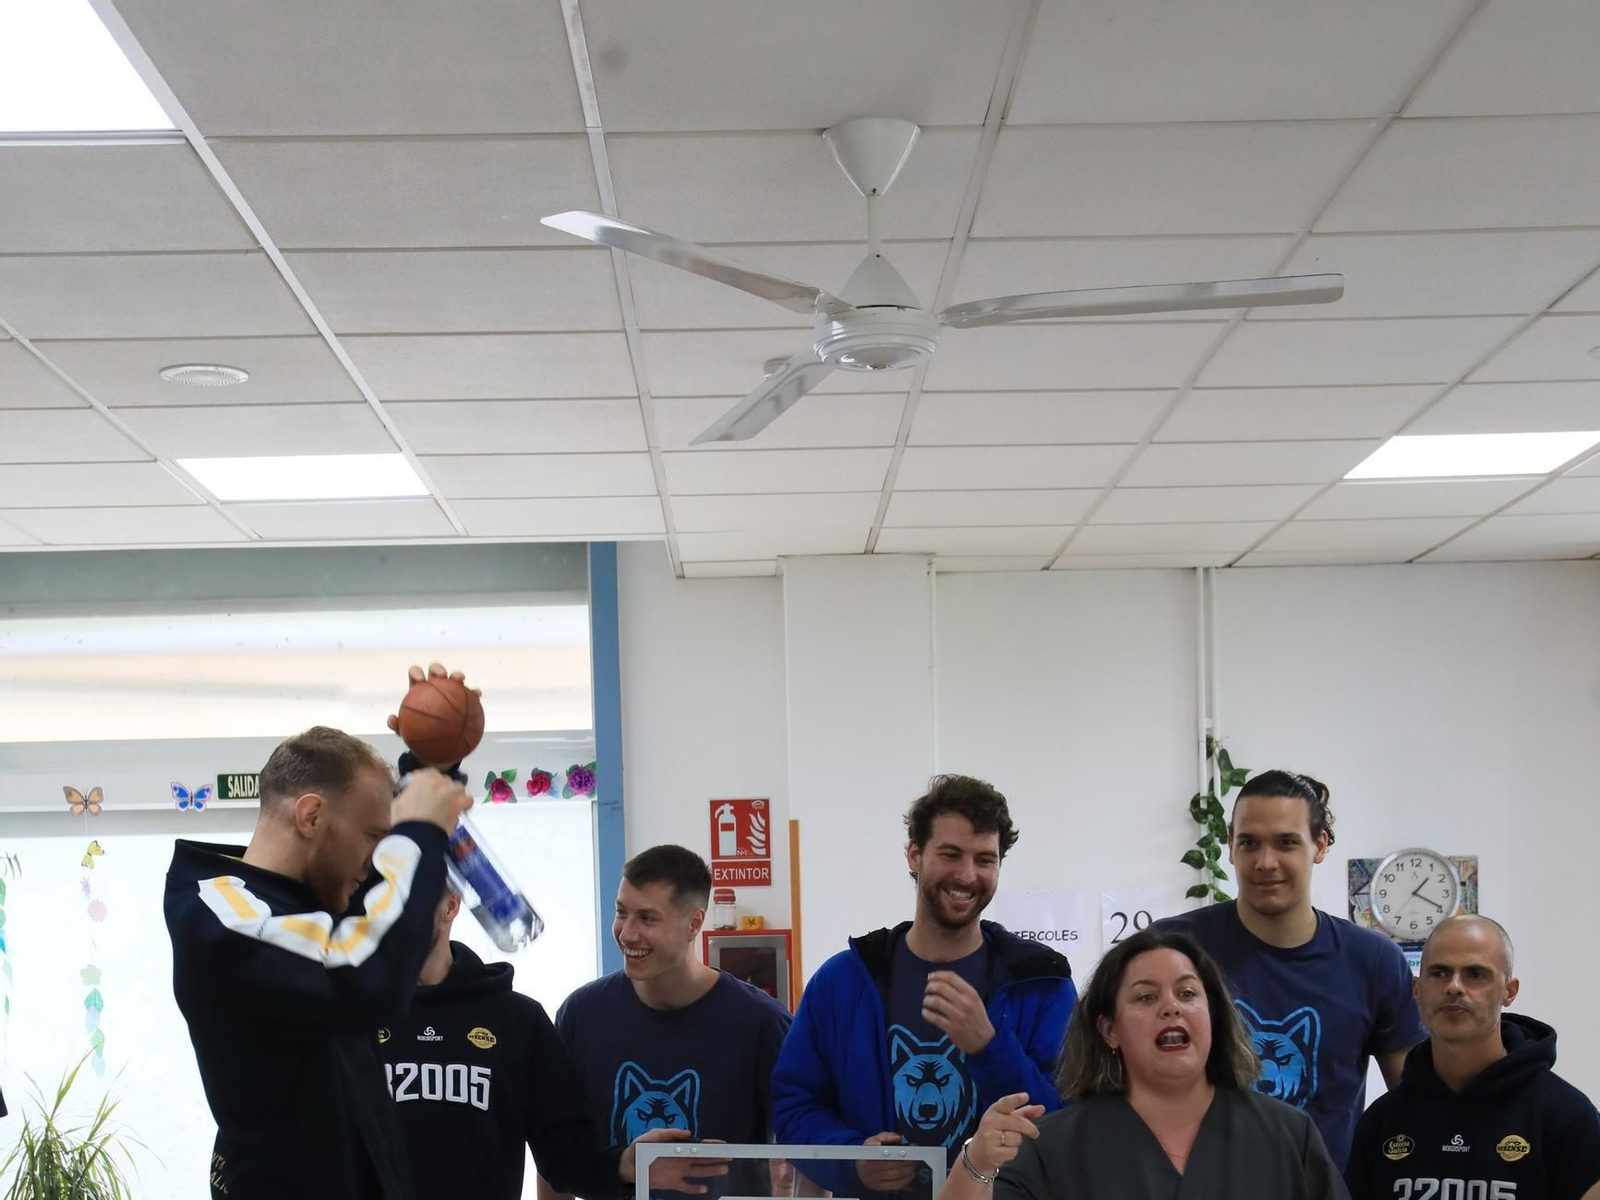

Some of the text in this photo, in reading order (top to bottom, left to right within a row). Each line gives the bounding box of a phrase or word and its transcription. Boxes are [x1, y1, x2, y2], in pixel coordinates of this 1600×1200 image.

[227, 775, 260, 798] SALIDA
[1410, 858, 1422, 867] 12
[1396, 863, 1404, 872] 11
[1429, 863, 1434, 872] 1
[714, 867, 770, 881] EXTINTOR
[1384, 873, 1396, 883] 10
[1438, 874, 1446, 883] 2
[1379, 889, 1387, 898] 9
[1442, 889, 1450, 899] 3
[1383, 905, 1390, 913] 8
[1394, 916, 1402, 925] 7
[1426, 916, 1434, 925] 5
[1410, 921, 1418, 930] 6
[1011, 930, 1079, 942] IERCOLES
